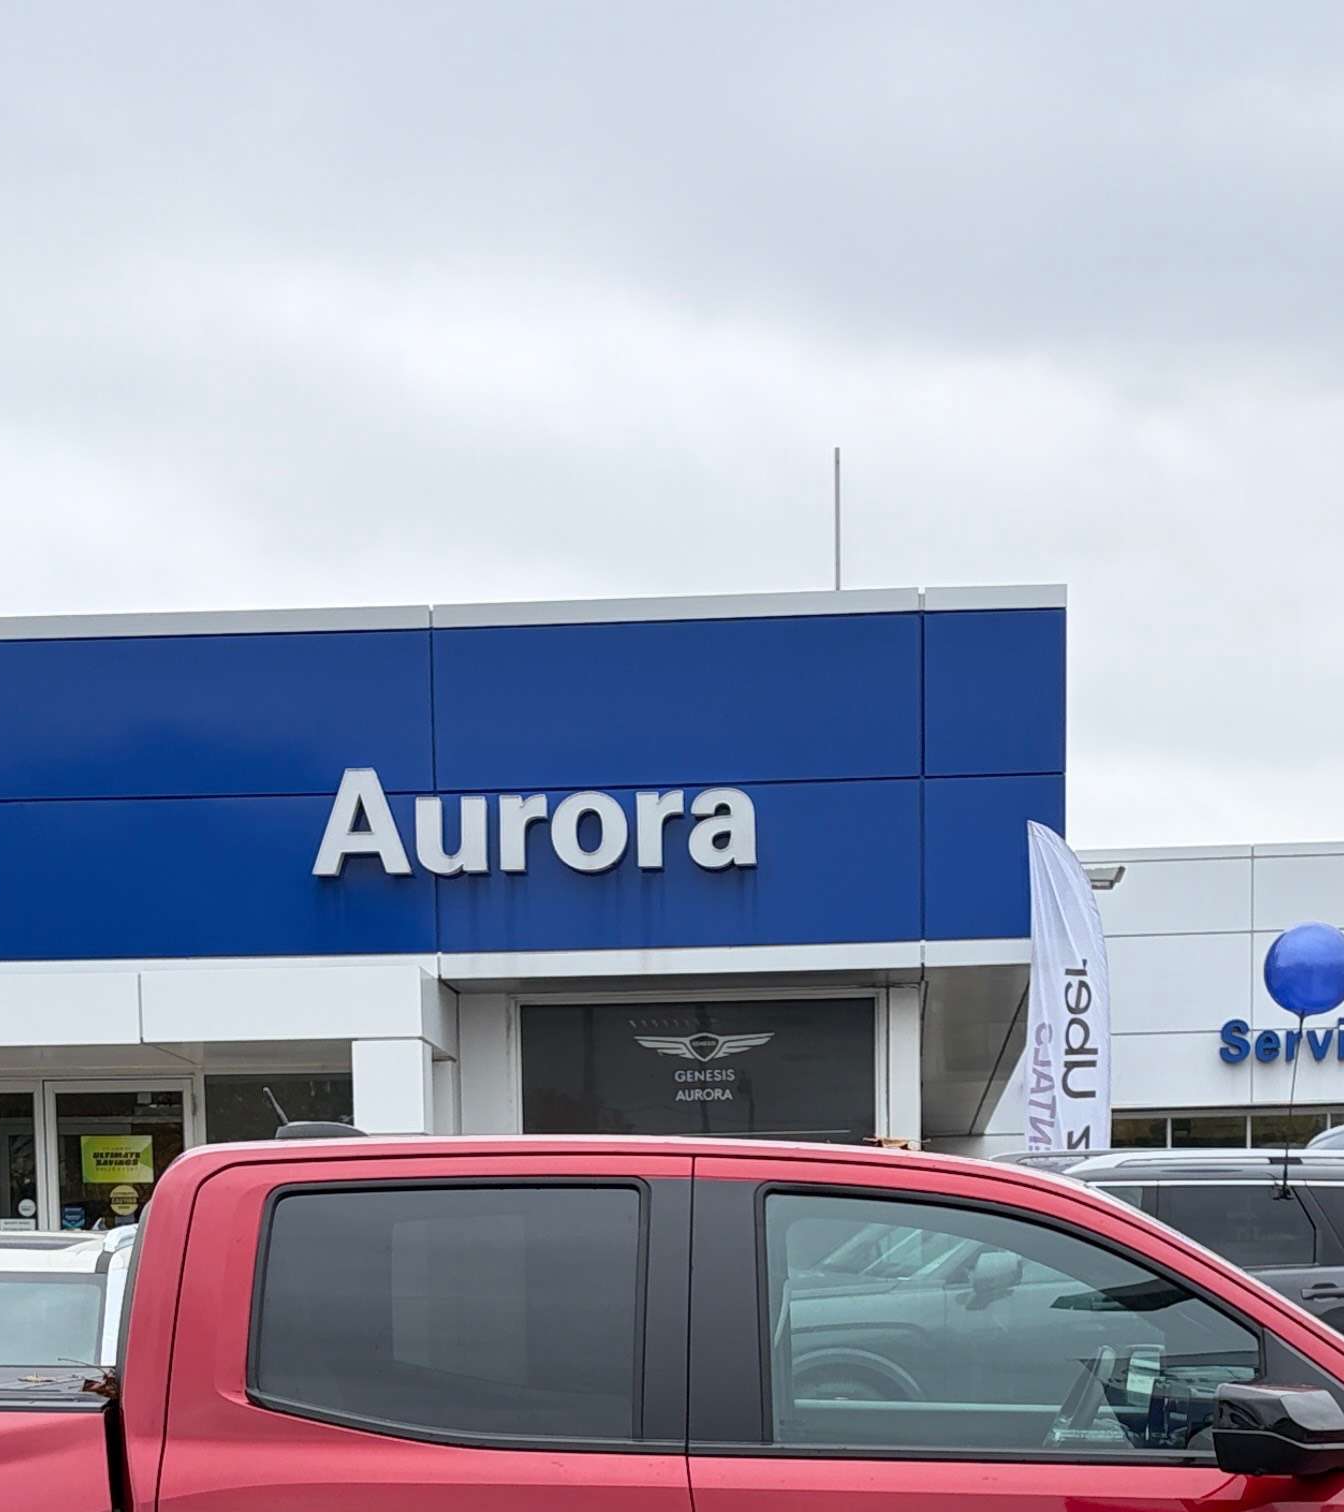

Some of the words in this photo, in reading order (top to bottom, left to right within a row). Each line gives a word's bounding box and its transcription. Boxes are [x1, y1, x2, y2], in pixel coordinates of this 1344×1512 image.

[312, 767, 757, 877] Aurora
[674, 1069, 735, 1082] GENESIS
[675, 1088, 733, 1101] AURORA
